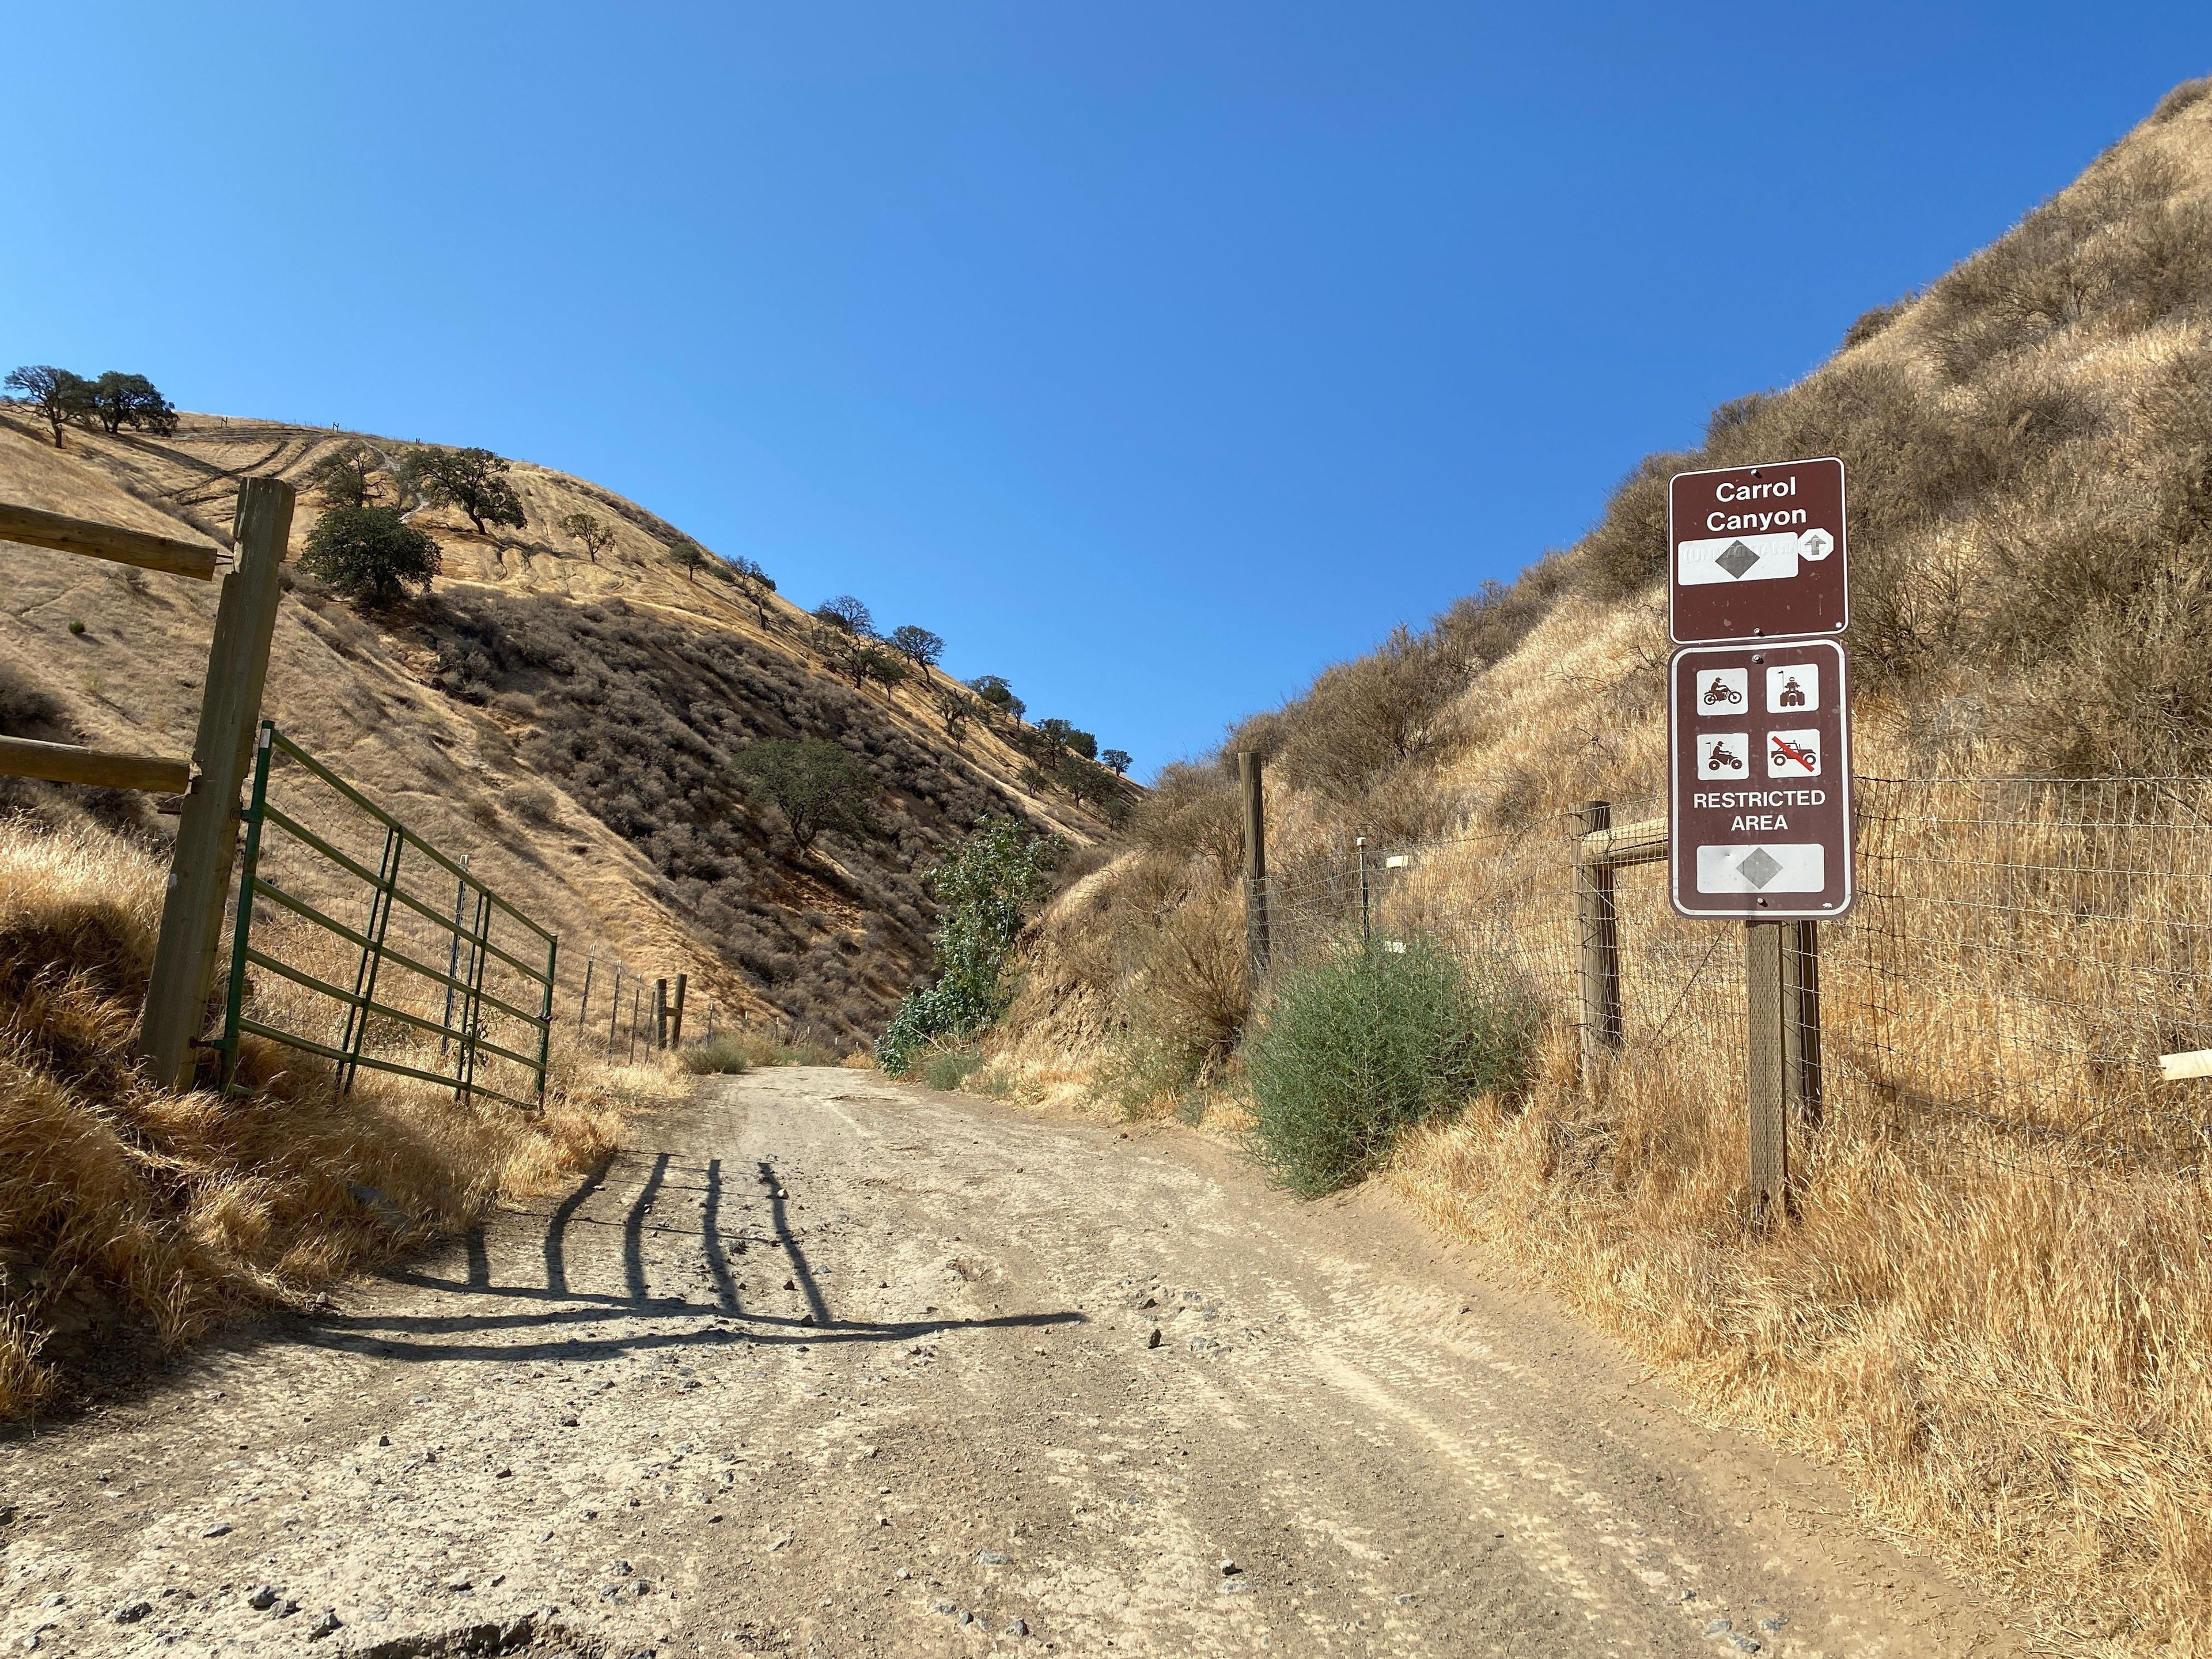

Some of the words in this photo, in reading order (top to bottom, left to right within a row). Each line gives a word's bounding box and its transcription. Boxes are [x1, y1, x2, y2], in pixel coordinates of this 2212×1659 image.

[1716, 476, 1796, 502] Carrol
[1707, 509, 1806, 532] Canyon
[1694, 790, 1825, 808] RESTRICTED
[1730, 815, 1789, 831] AREA
